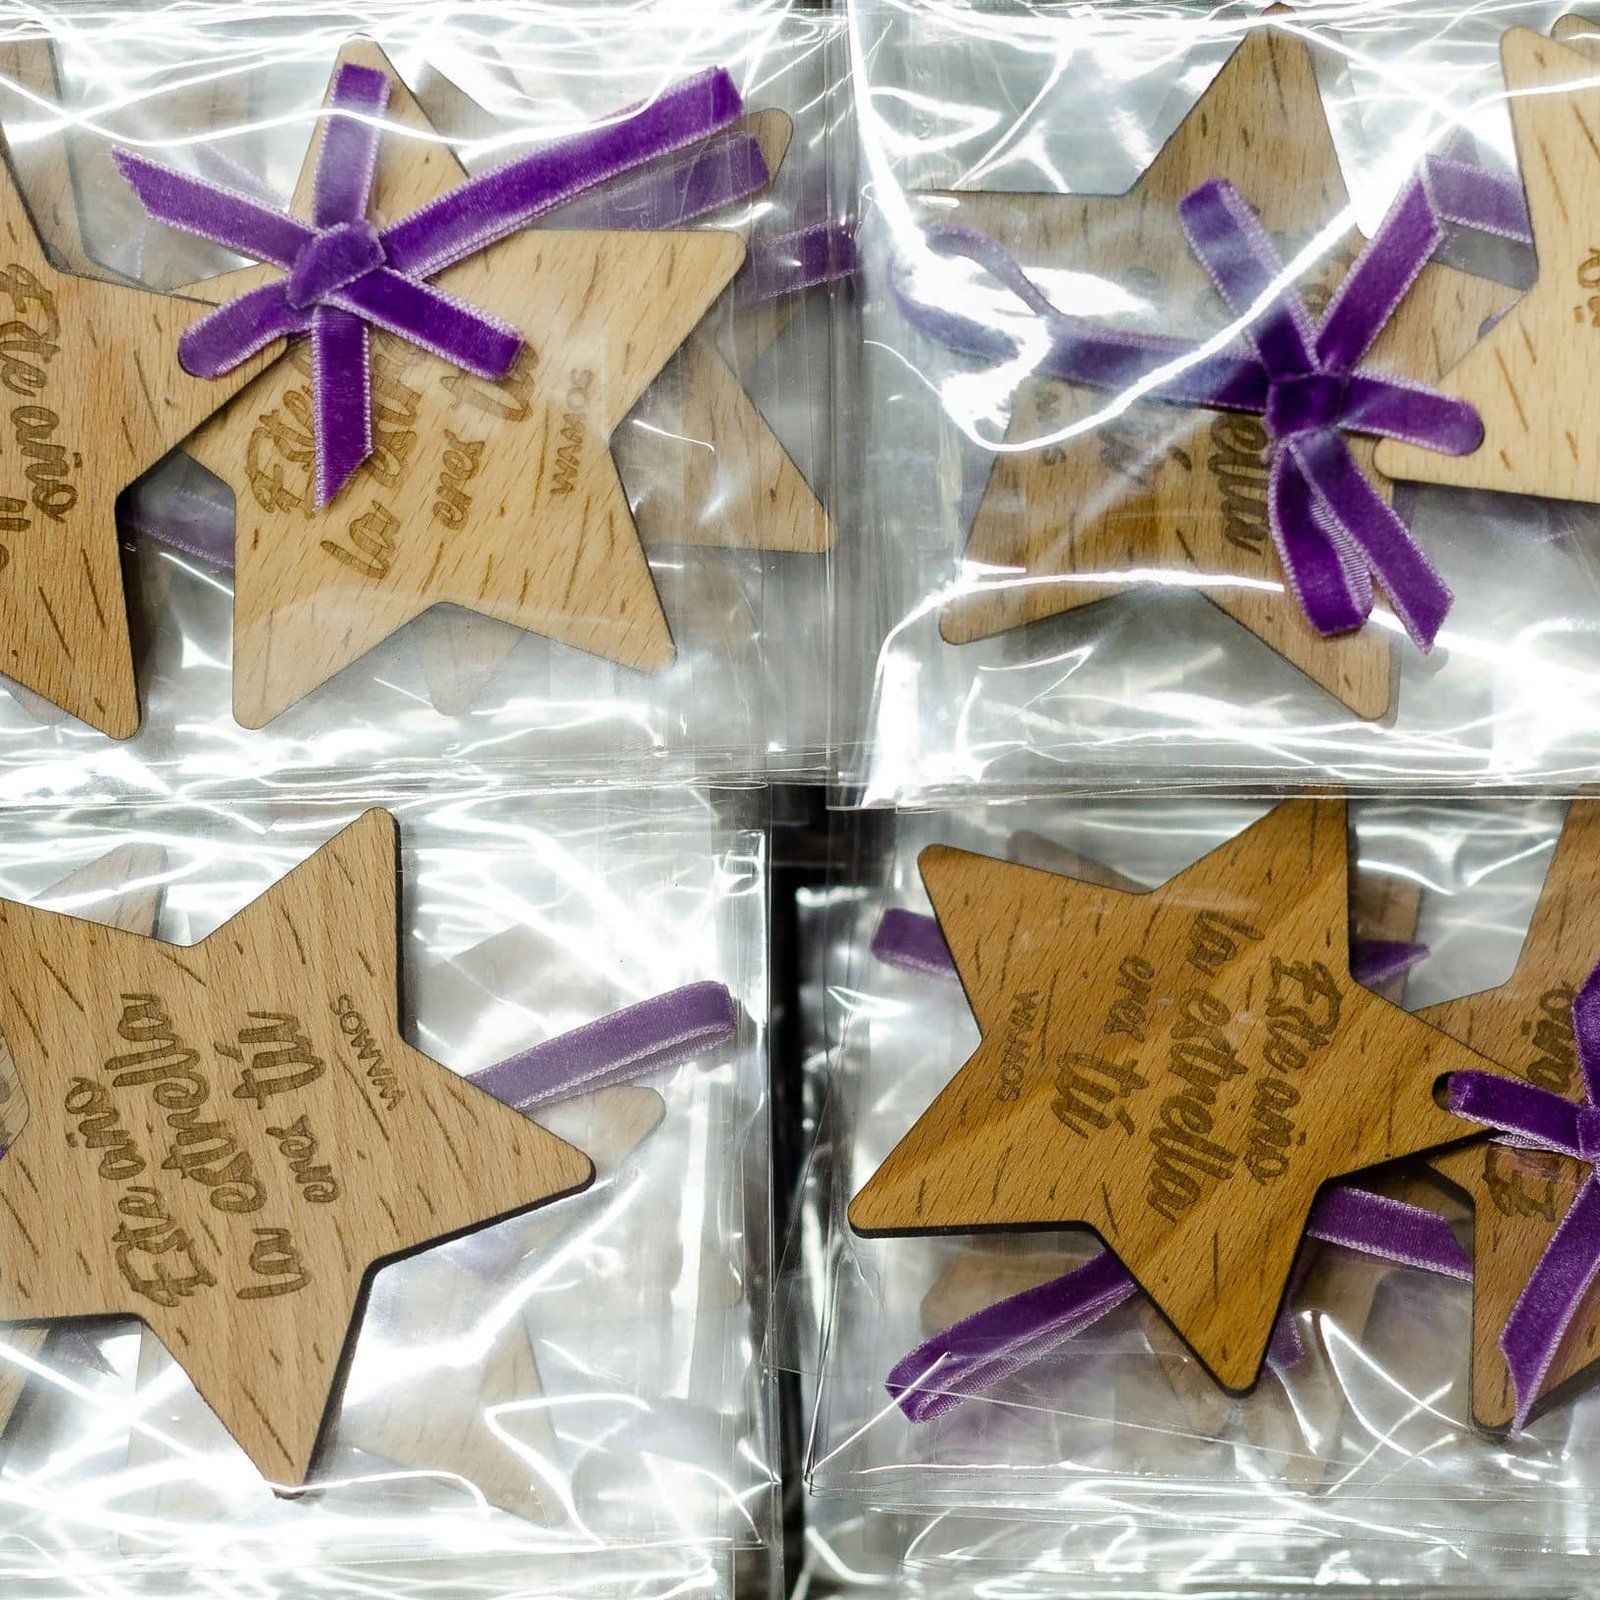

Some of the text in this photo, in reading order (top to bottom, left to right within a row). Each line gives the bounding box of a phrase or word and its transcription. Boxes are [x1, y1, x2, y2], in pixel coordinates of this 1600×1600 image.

[11, 405, 83, 523] año
[319, 500, 399, 579] la
[433, 429, 485, 530] eres
[214, 1011, 340, 1203] eres tú
[330, 994, 405, 1111] WAMOS
[1051, 955, 1154, 1139] eres tú
[1147, 910, 1265, 1224] la estrella
[1243, 956, 1343, 1186] Este año
[65, 1077, 217, 1307] Este año
[104, 993, 313, 1300] la estrella
